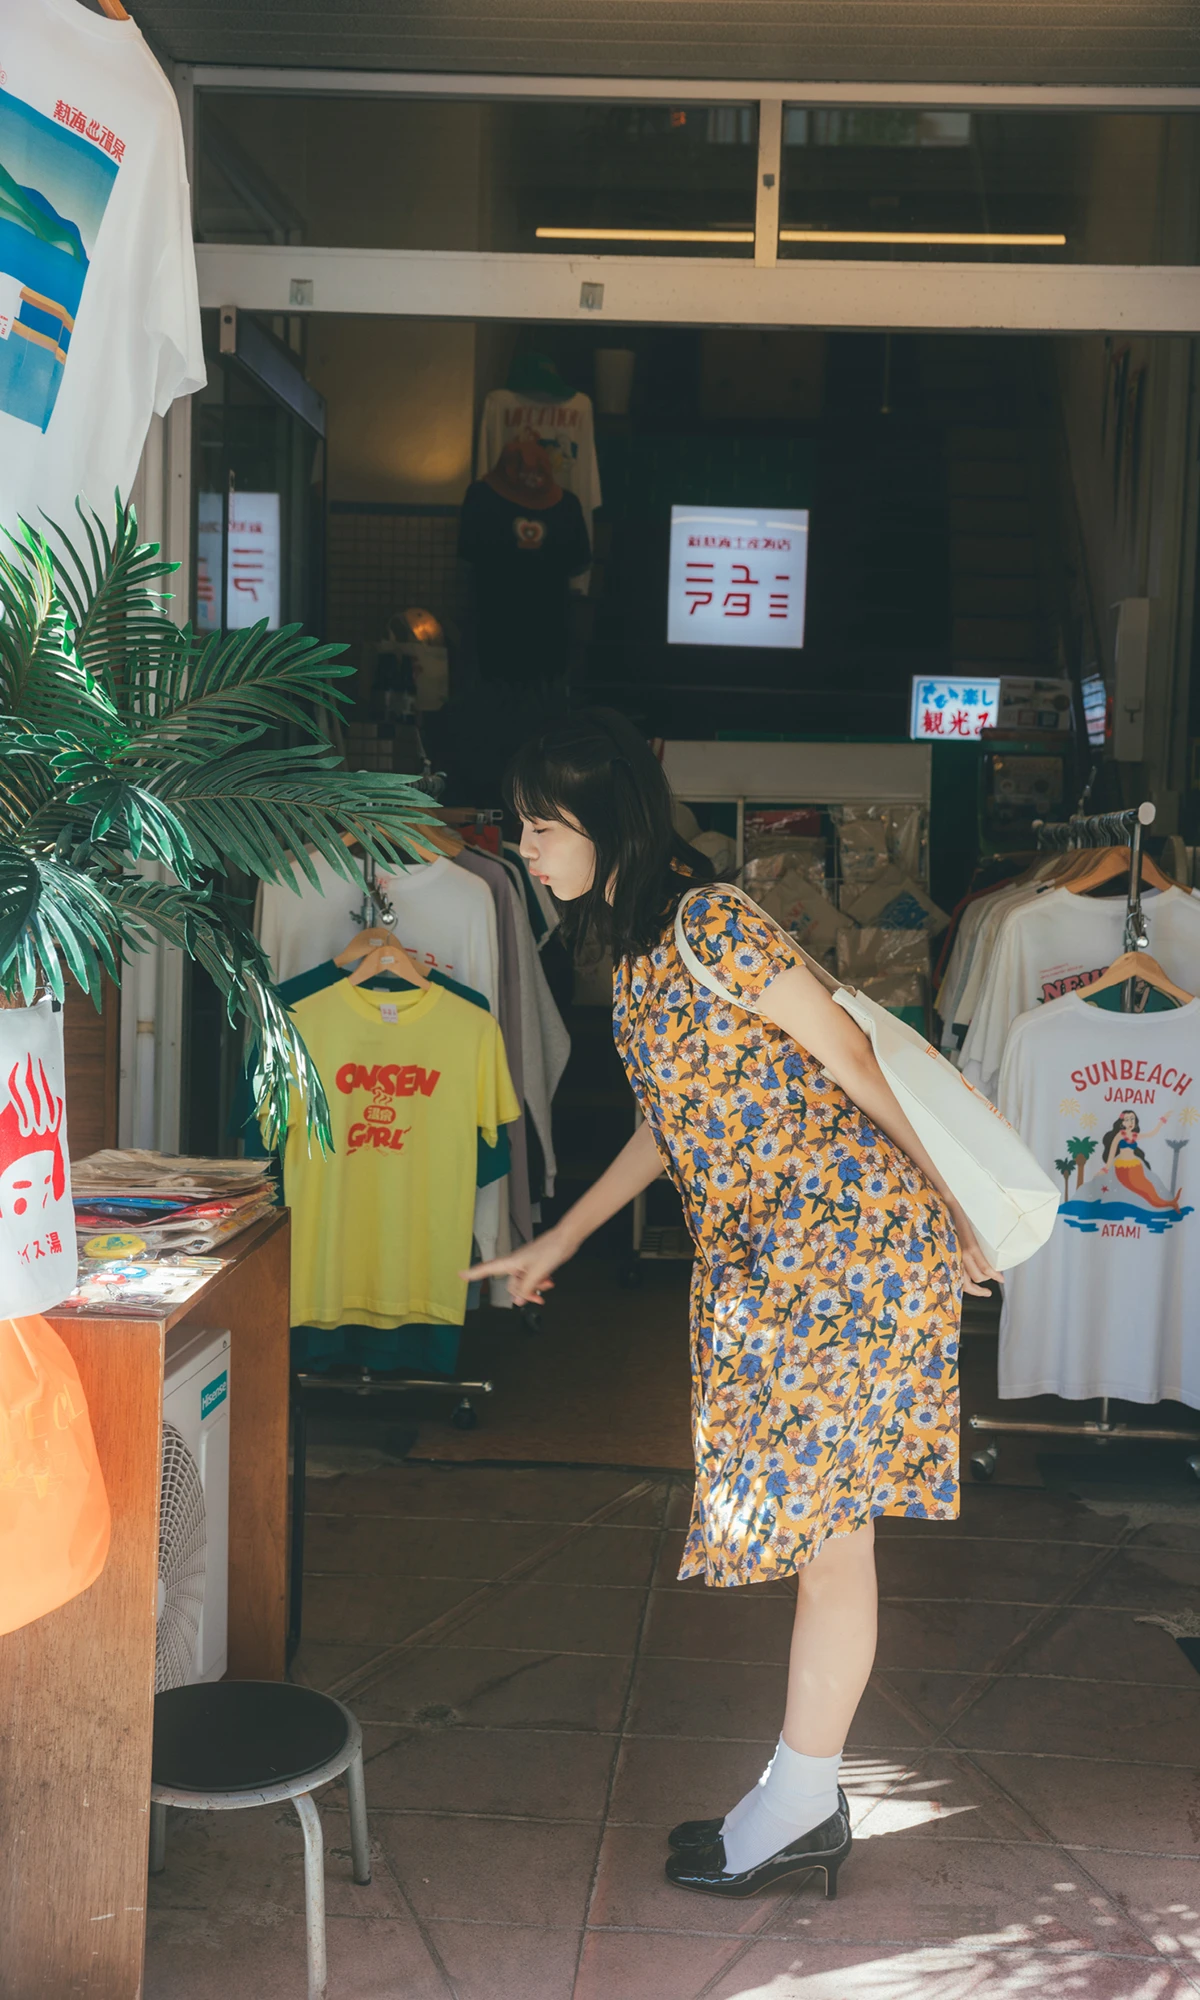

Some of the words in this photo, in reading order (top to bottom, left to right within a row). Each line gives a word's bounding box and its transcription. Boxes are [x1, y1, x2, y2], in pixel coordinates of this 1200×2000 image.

[685, 563, 791, 585] ニュー
[685, 591, 789, 618] アタミ
[335, 1063, 441, 1098] ONSEN
[1070, 1058, 1193, 1097] SUNBEACH
[1104, 1087, 1156, 1105] JAPAN
[367, 1106, 393, 1122] 温泉
[347, 1122, 405, 1151] GIRL
[1101, 1223, 1141, 1240] ATAMI
[17, 1231, 63, 1265] イス湯
[202, 1381, 227, 1411] Hisense
